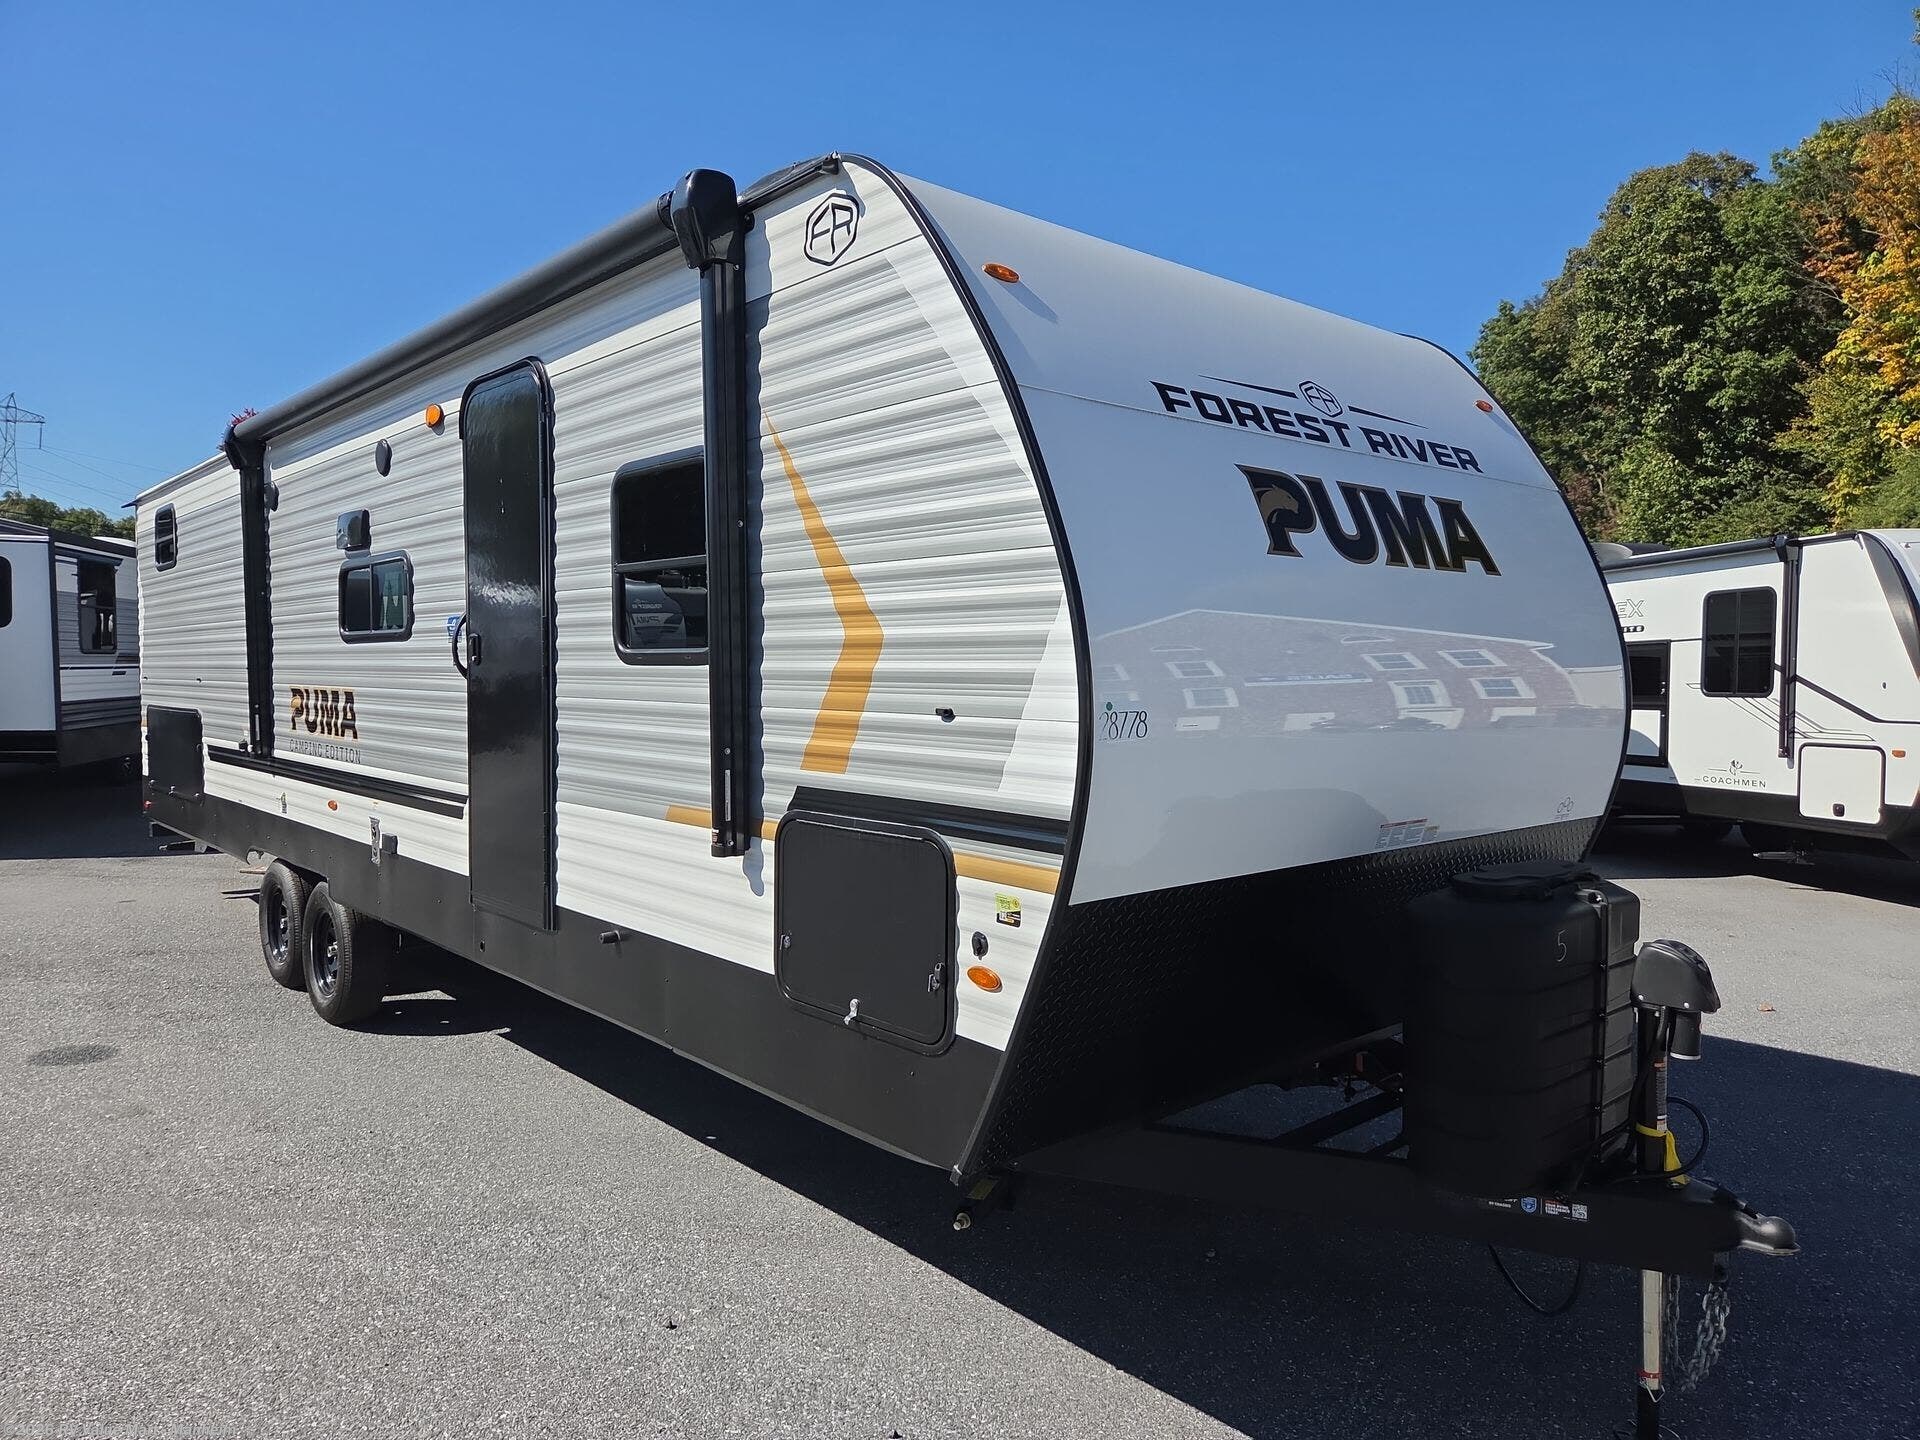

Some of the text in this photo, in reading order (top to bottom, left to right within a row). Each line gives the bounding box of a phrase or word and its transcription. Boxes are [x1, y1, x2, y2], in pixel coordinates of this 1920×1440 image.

[1150, 380, 1484, 473] FOREST RIVER
[1234, 463, 1501, 576] PUMA
[1615, 599, 1645, 618] EX
[1622, 625, 1643, 633] ITE
[289, 685, 359, 742] PUMA
[1098, 710, 1149, 741] 28778
[289, 738, 362, 764] CAMPING EDITION
[1702, 775, 1767, 788] COACHMEN
